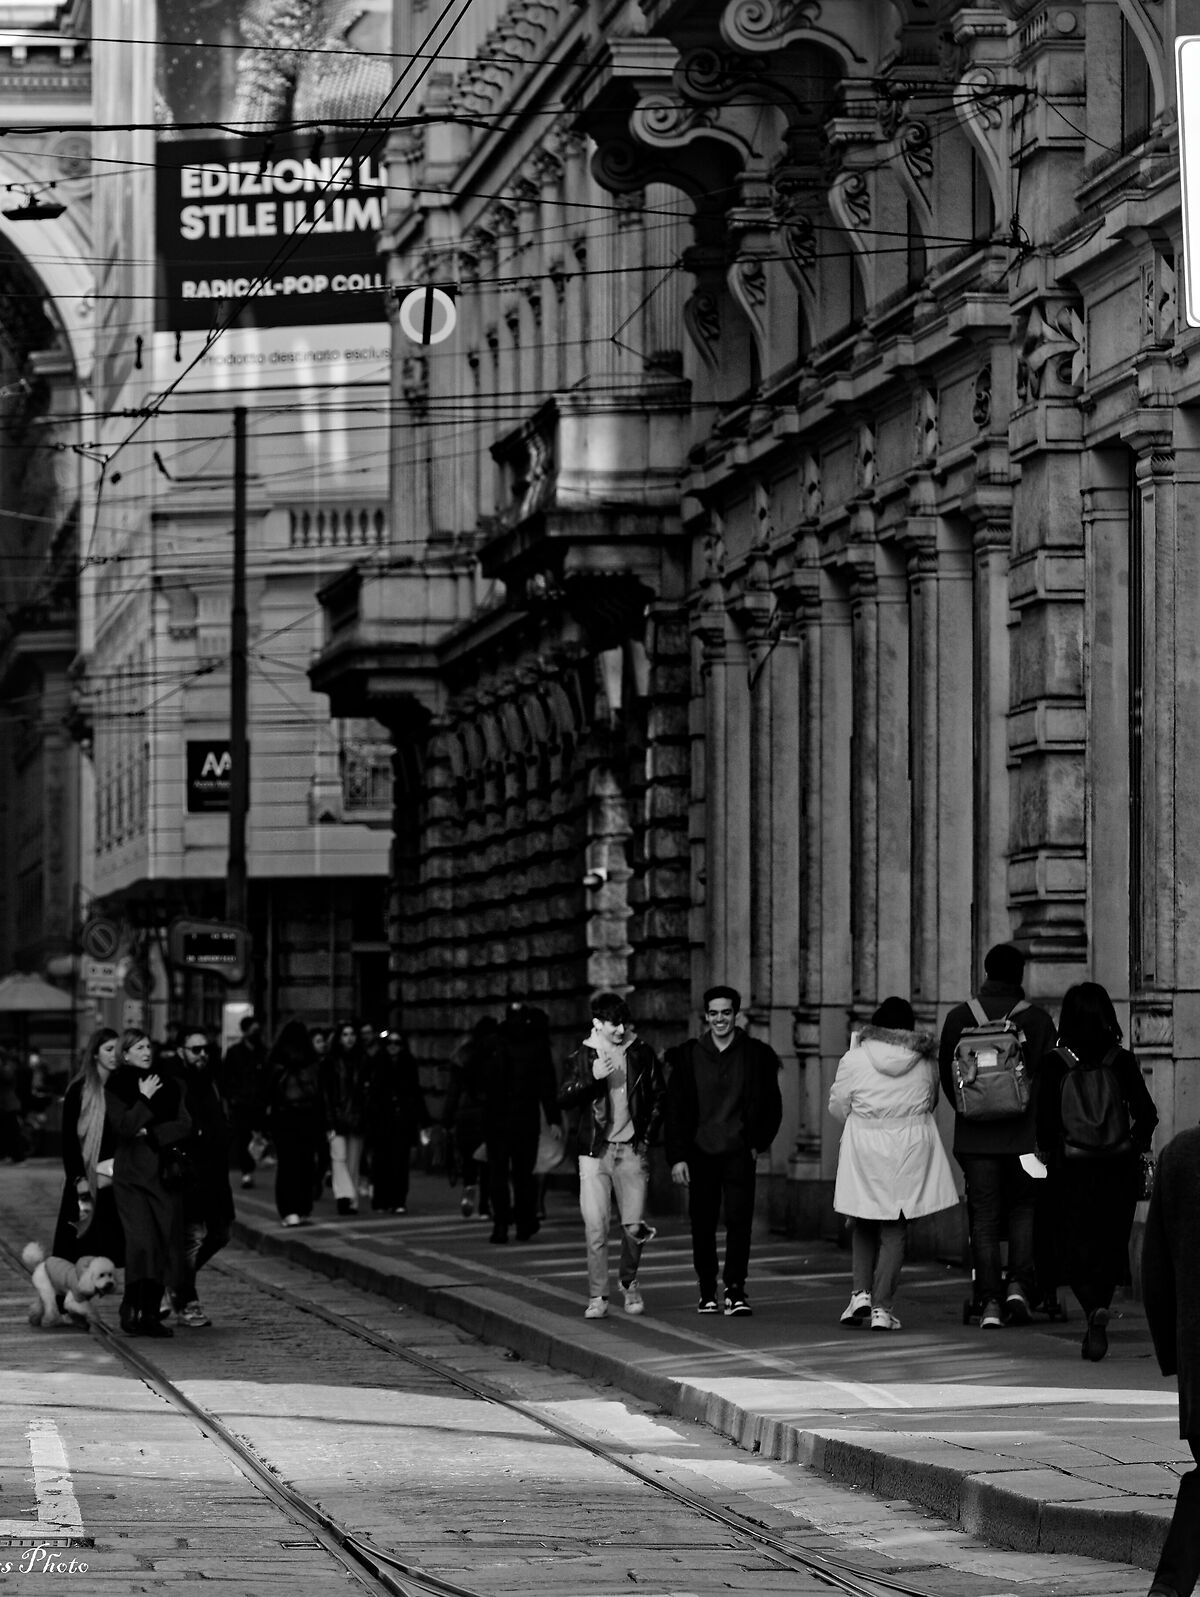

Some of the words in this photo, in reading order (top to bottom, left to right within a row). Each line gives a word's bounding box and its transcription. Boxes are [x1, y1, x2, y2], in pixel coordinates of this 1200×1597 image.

[181, 156, 353, 199] EDIZIONE
[180, 201, 277, 240] STILE
[181, 274, 329, 298] RADICAL-POP
